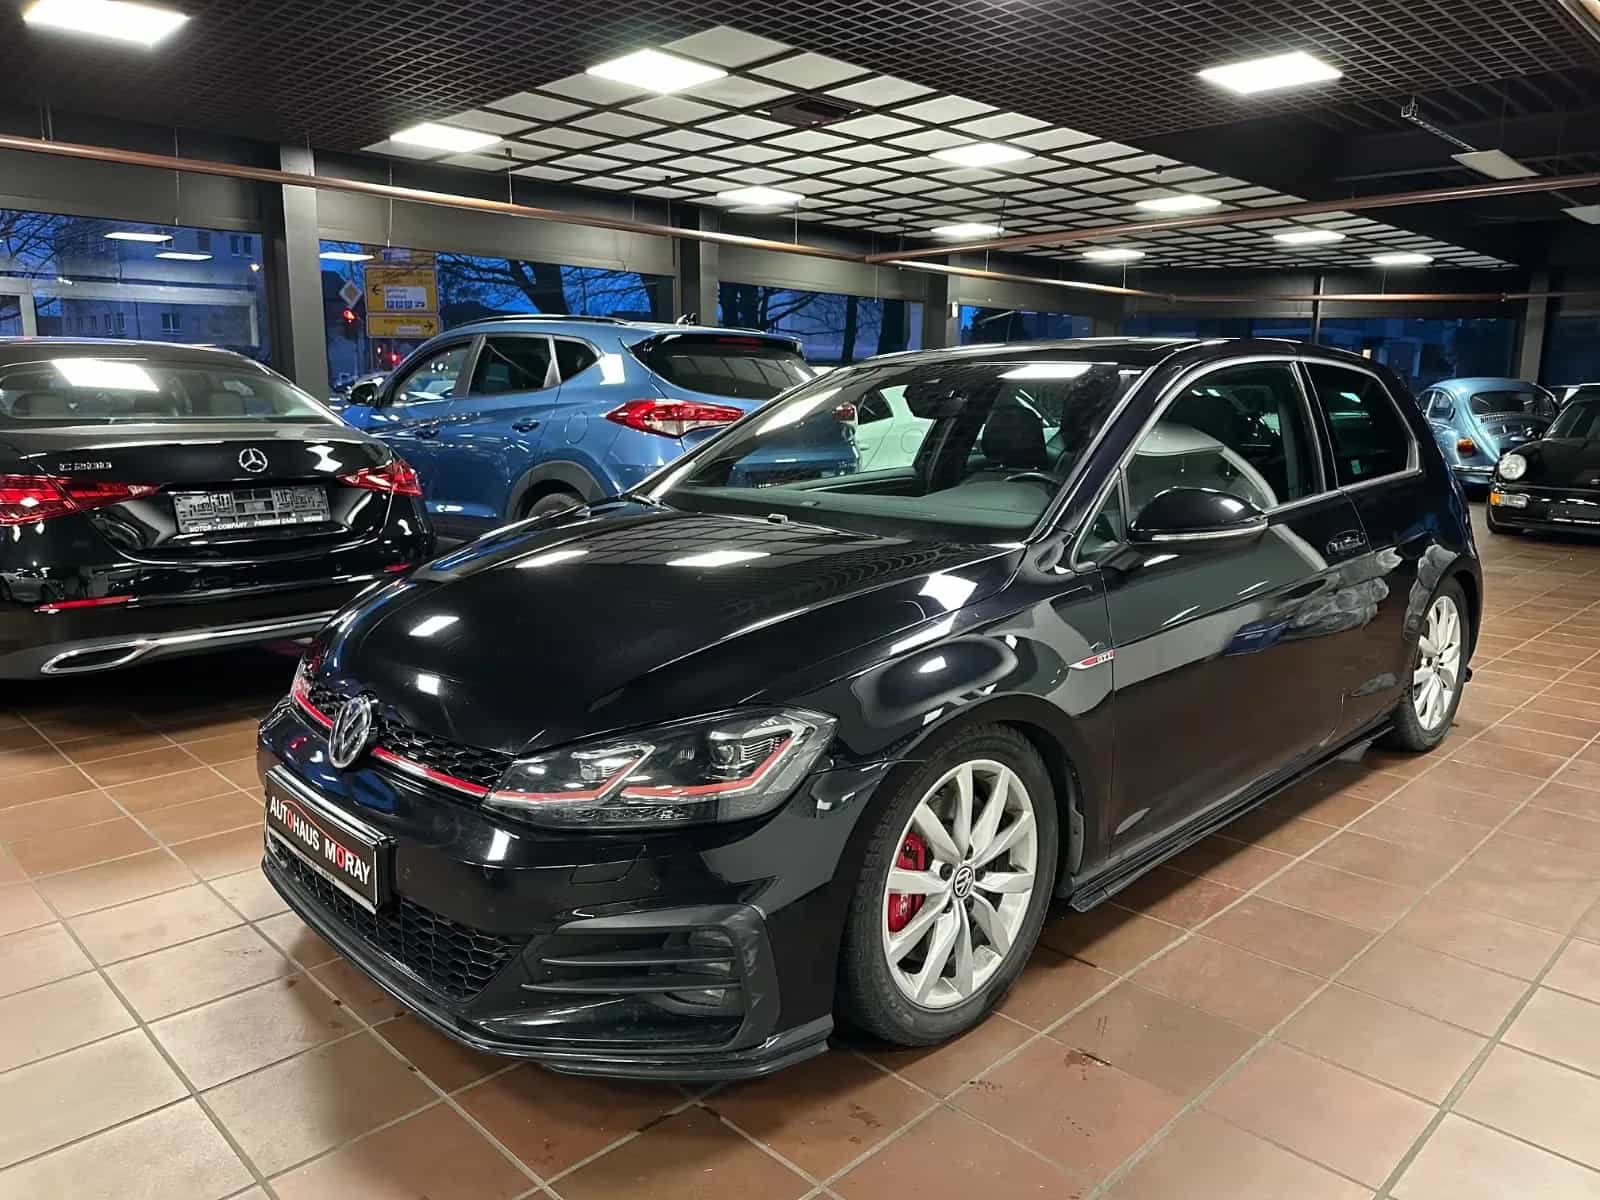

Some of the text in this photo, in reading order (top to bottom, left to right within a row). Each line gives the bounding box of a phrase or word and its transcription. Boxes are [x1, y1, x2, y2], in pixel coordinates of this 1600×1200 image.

[217, 521, 248, 530] COMPANY
[269, 796, 320, 852] AUTOHAUS
[324, 838, 371, 886] MORAY
